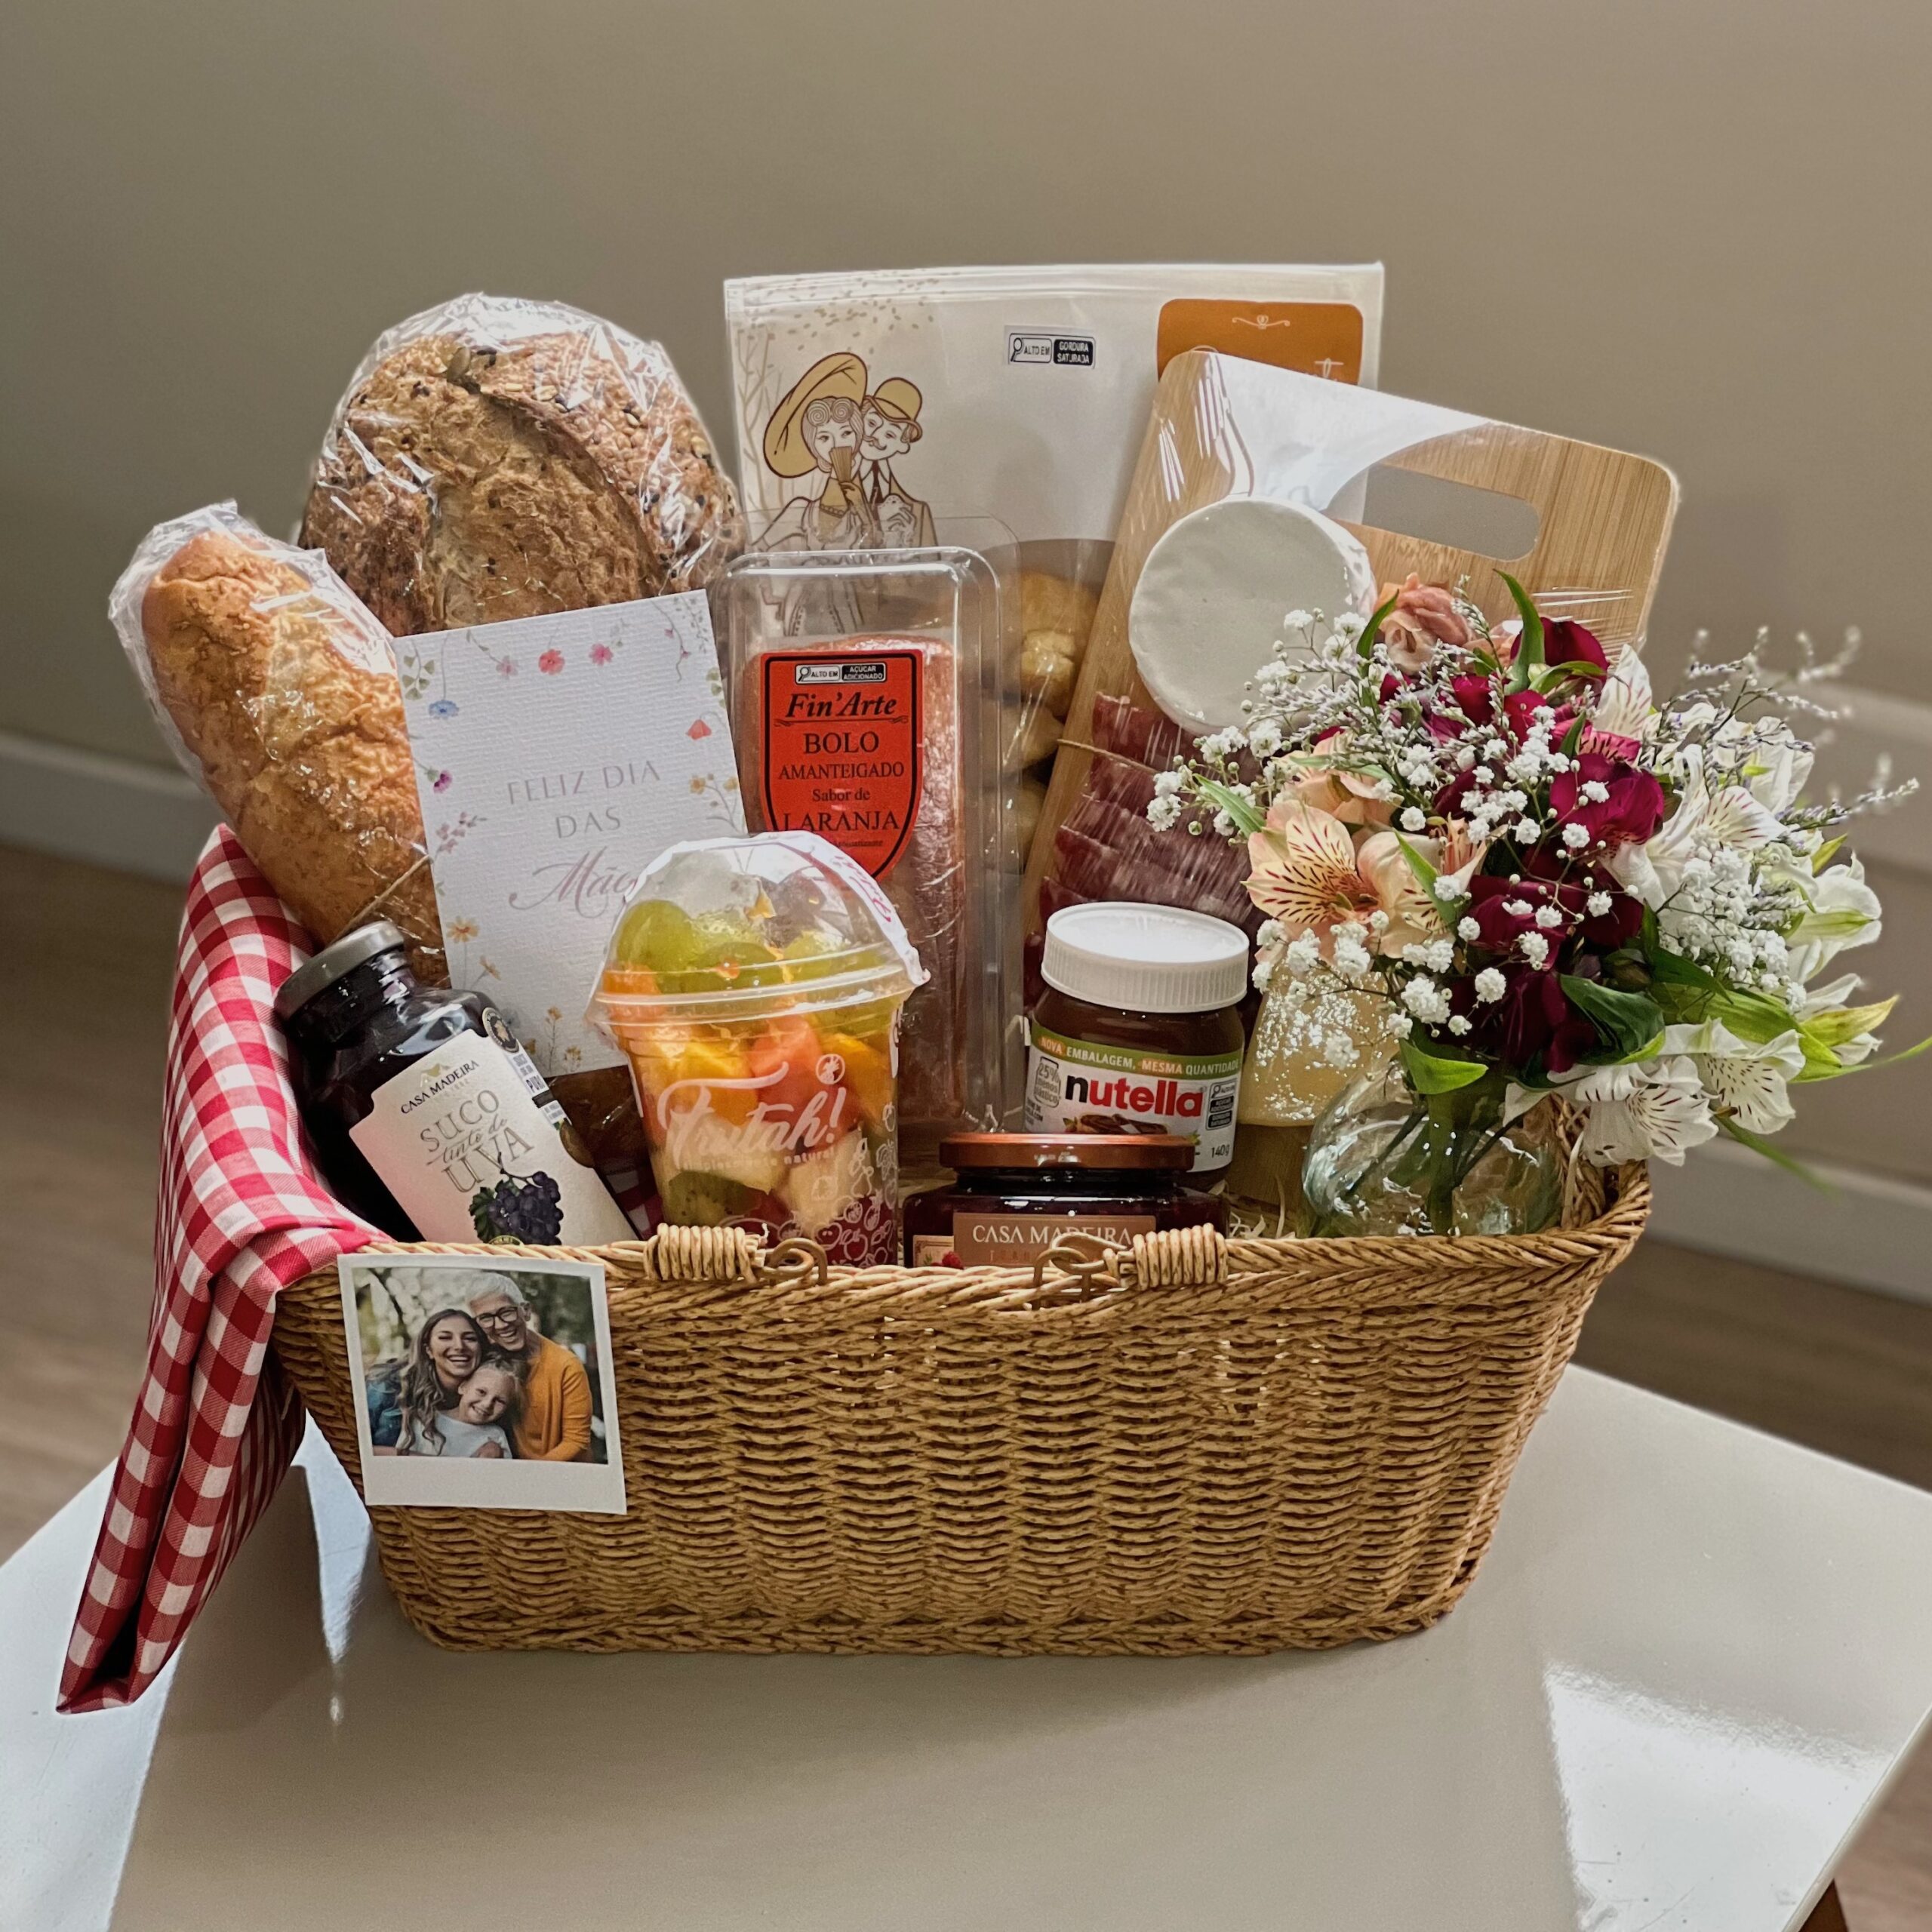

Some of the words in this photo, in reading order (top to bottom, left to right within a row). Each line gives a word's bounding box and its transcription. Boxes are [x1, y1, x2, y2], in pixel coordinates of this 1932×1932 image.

[1023, 346, 1040, 355] ALTO
[1041, 346, 1051, 355] EM
[1059, 341, 1089, 352] GORDURA
[1057, 353, 1090, 364] SATURADA
[803, 731, 879, 755] BOLO
[778, 761, 906, 780] AMANTEIGADO
[507, 771, 587, 804] FELIZ
[602, 760, 660, 789] DIA
[812, 788, 851, 801] Sabor
[854, 787, 871, 801] de
[555, 806, 621, 838] DAS
[782, 811, 900, 832] LARANJA
[1040, 1036, 1063, 1055] NOVA
[1066, 1046, 1137, 1070] EMBALAGEM,
[1142, 1059, 1183, 1075] MESMA
[1037, 1063, 1060, 1083] 25%
[401, 1091, 430, 1114] CASA
[430, 1060, 480, 1096] MADEIRA
[1066, 1075, 1204, 1118] nutella
[420, 1090, 500, 1152] SUCO
[489, 1114, 508, 1134] de
[441, 1127, 535, 1192] UVA
[973, 1225, 1025, 1244] CASA
